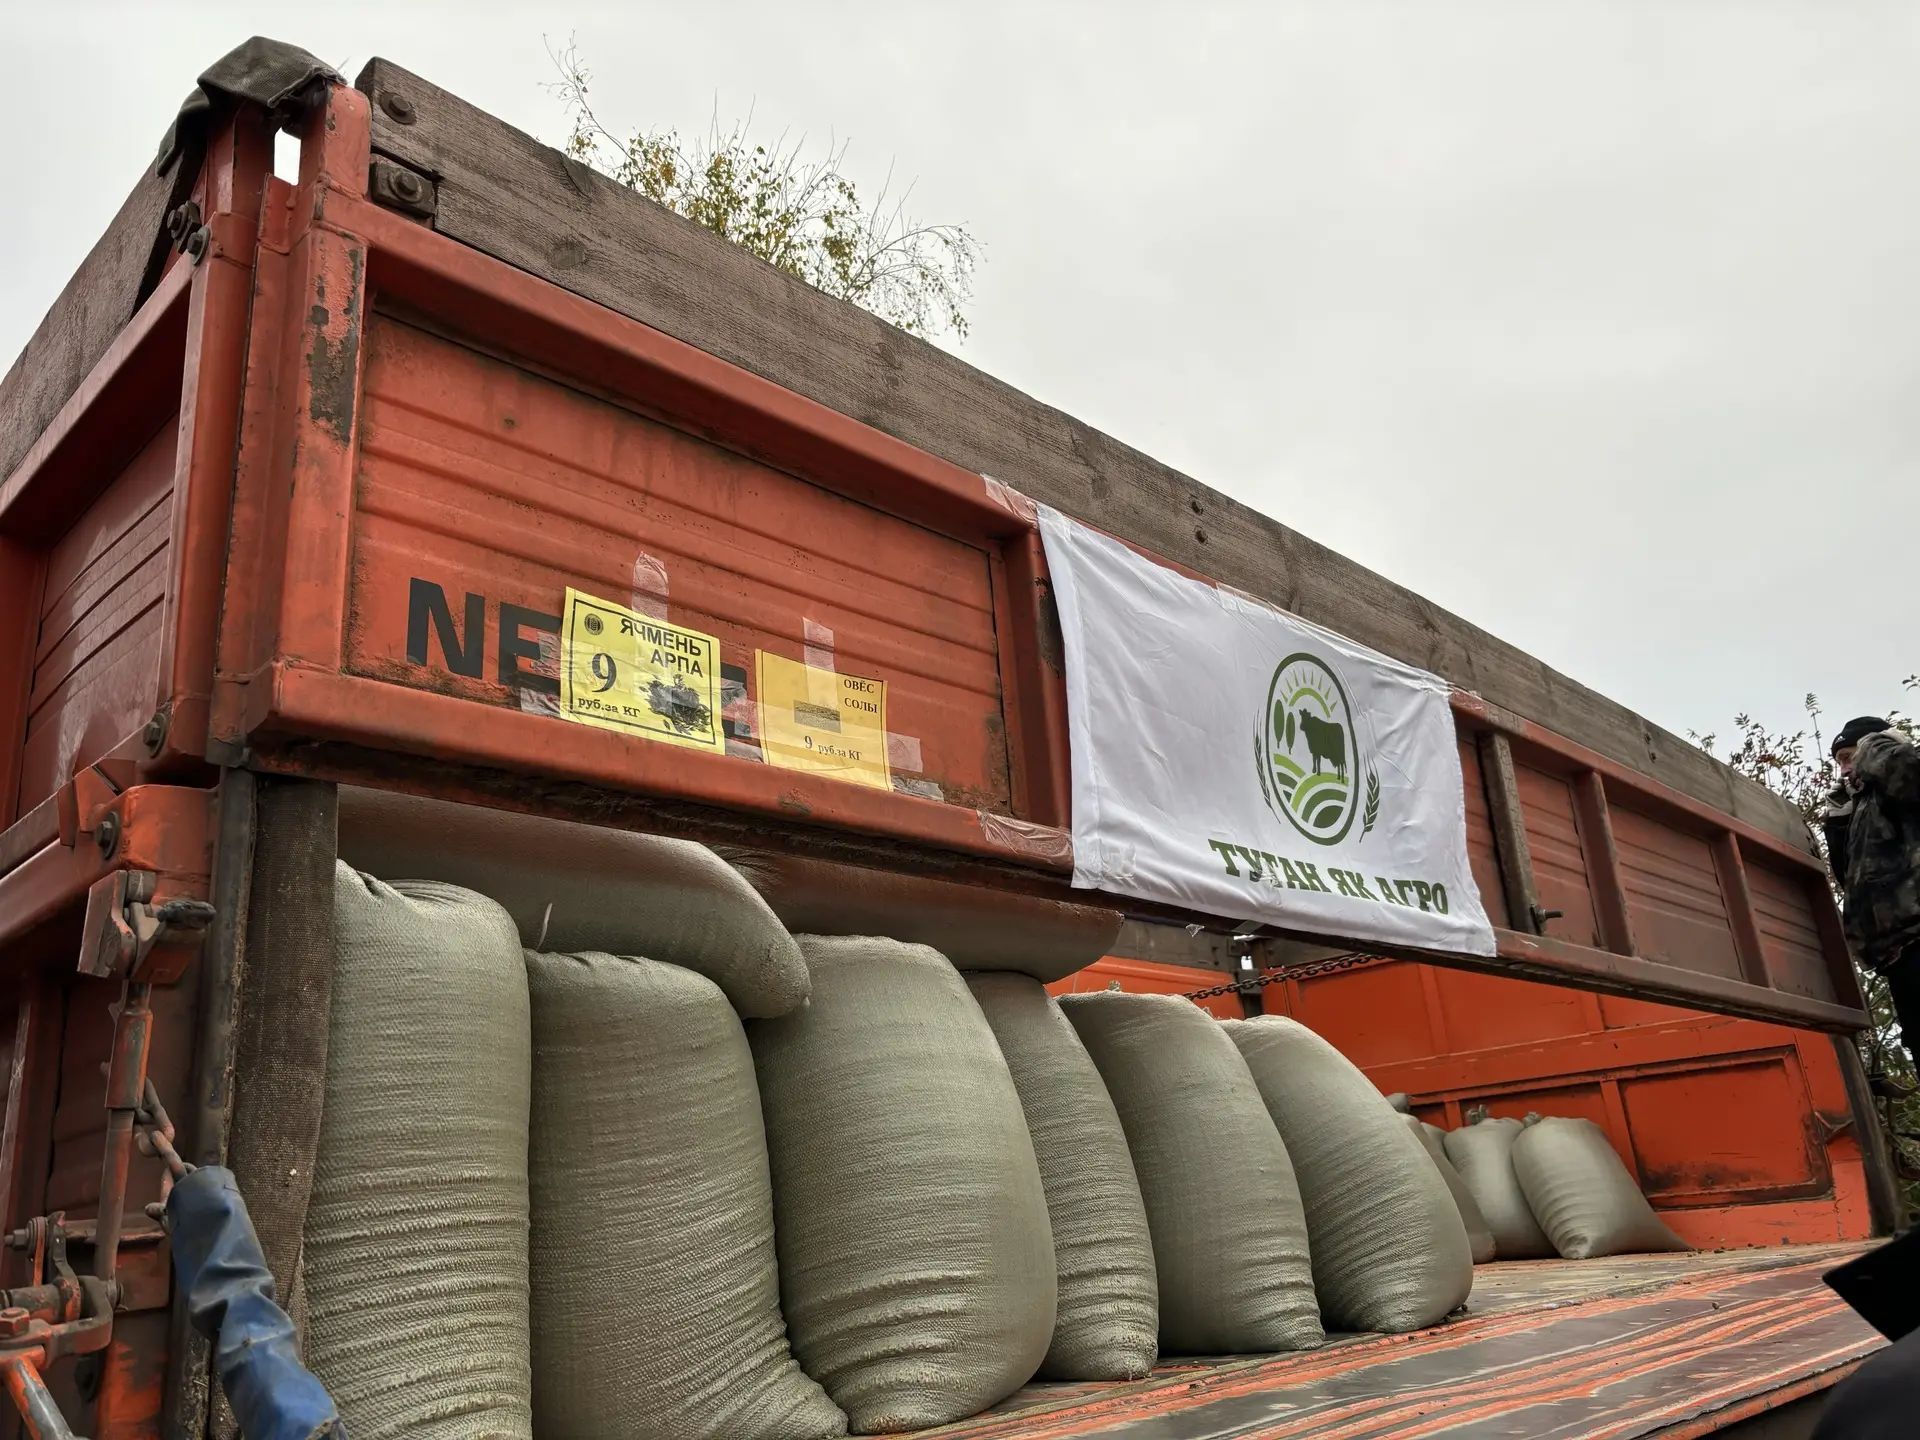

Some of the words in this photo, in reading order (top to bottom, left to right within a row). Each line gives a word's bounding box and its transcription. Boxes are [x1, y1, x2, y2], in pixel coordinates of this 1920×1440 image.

[620, 618, 702, 657] ЯЧМЕНЬ
[591, 652, 617, 693] 9
[650, 648, 704, 679] АРПА
[843, 678, 875, 694] ОВЁС
[844, 697, 878, 714] СОЛЫ
[804, 735, 813, 749] 9
[1208, 838, 1332, 893] ТУГАН
[1326, 867, 1380, 902] ЯК
[1374, 876, 1449, 915] АГРО
